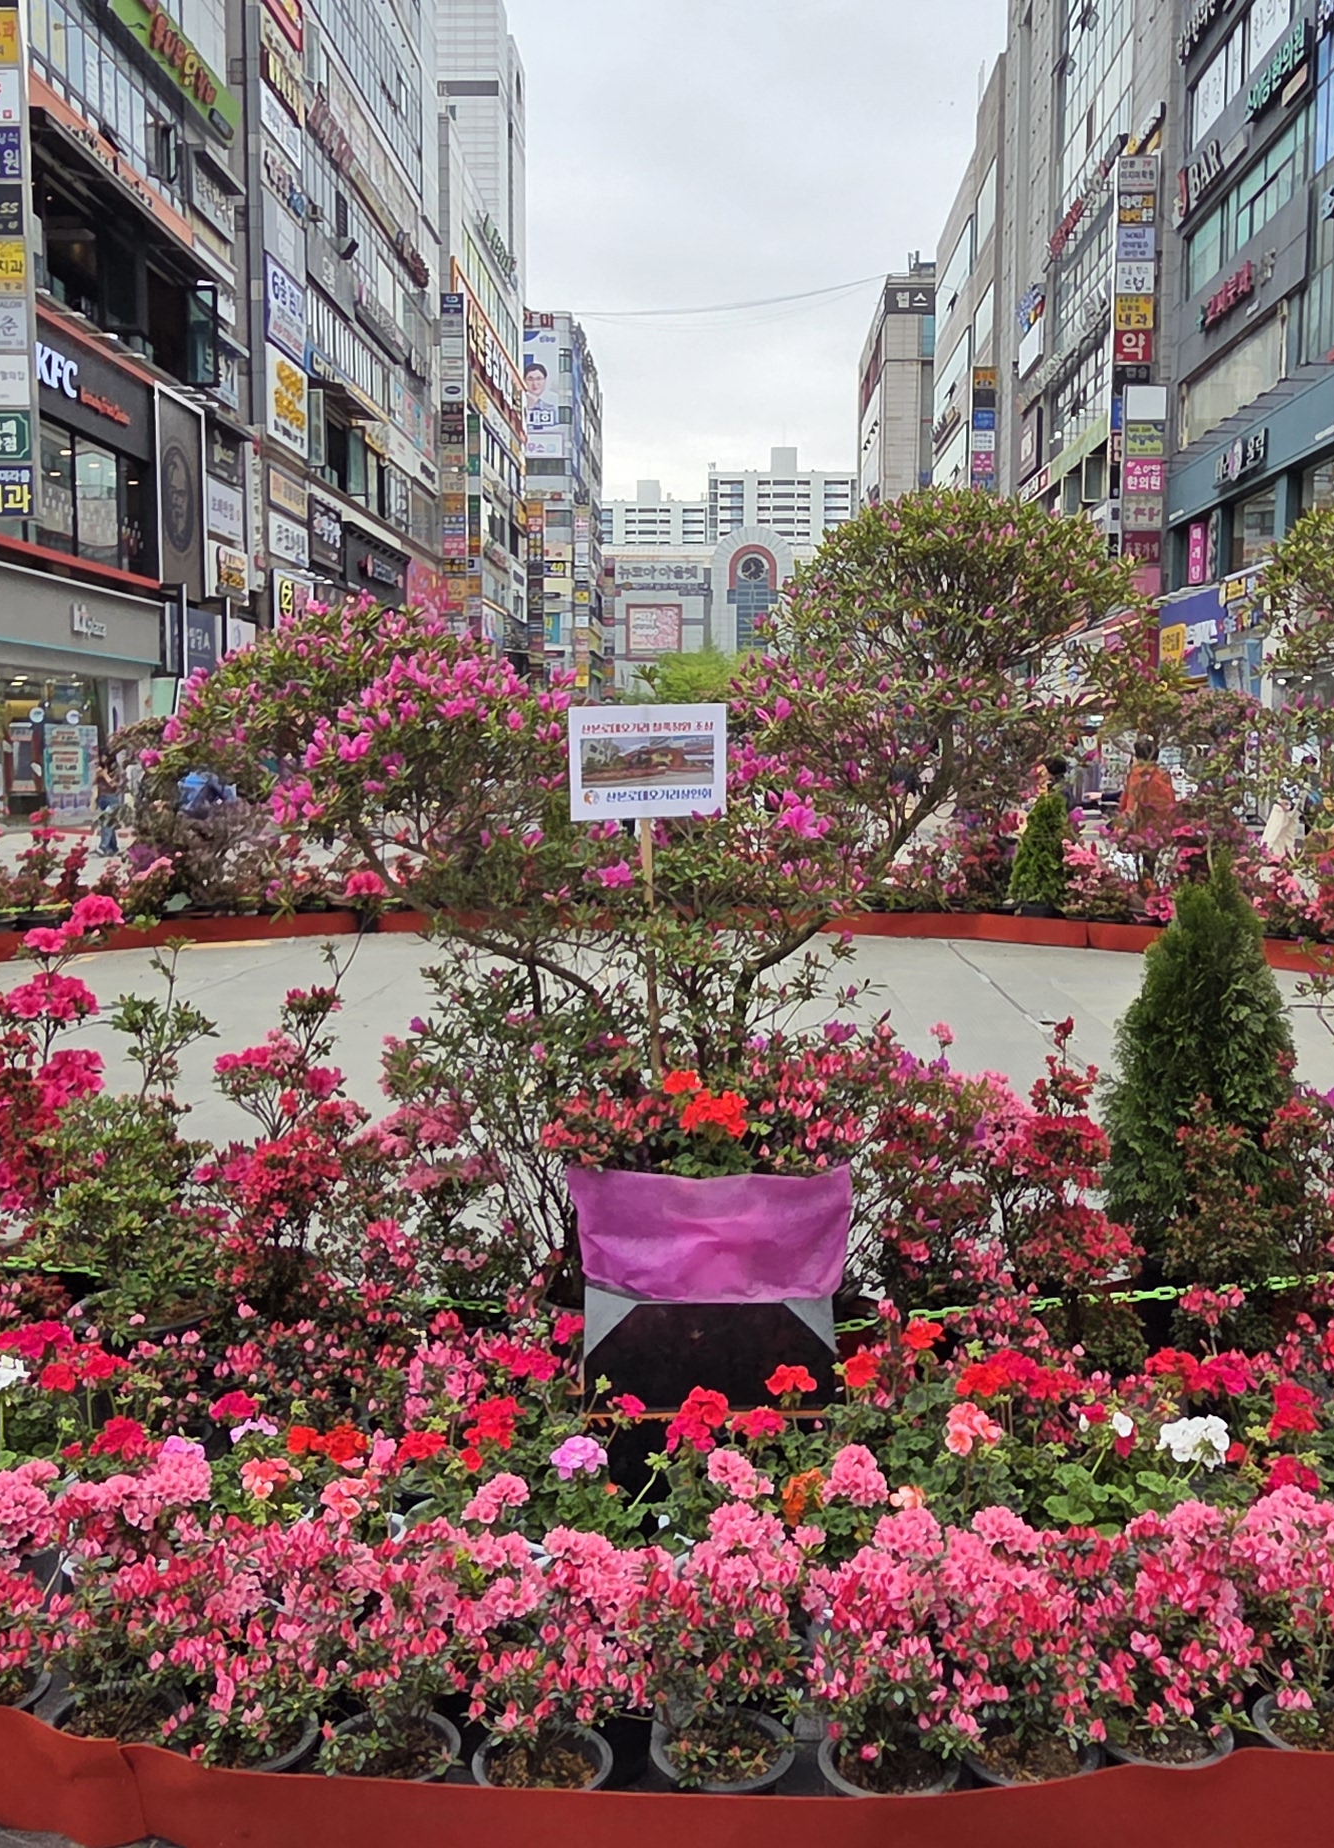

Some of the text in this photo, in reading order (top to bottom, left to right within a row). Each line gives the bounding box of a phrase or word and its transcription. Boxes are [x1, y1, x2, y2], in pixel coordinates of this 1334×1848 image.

[1118, 313, 1148, 326] 내과
[1122, 332, 1146, 360] 약
[35, 341, 78, 398] KFC
[1126, 475, 1162, 490] 한의원
